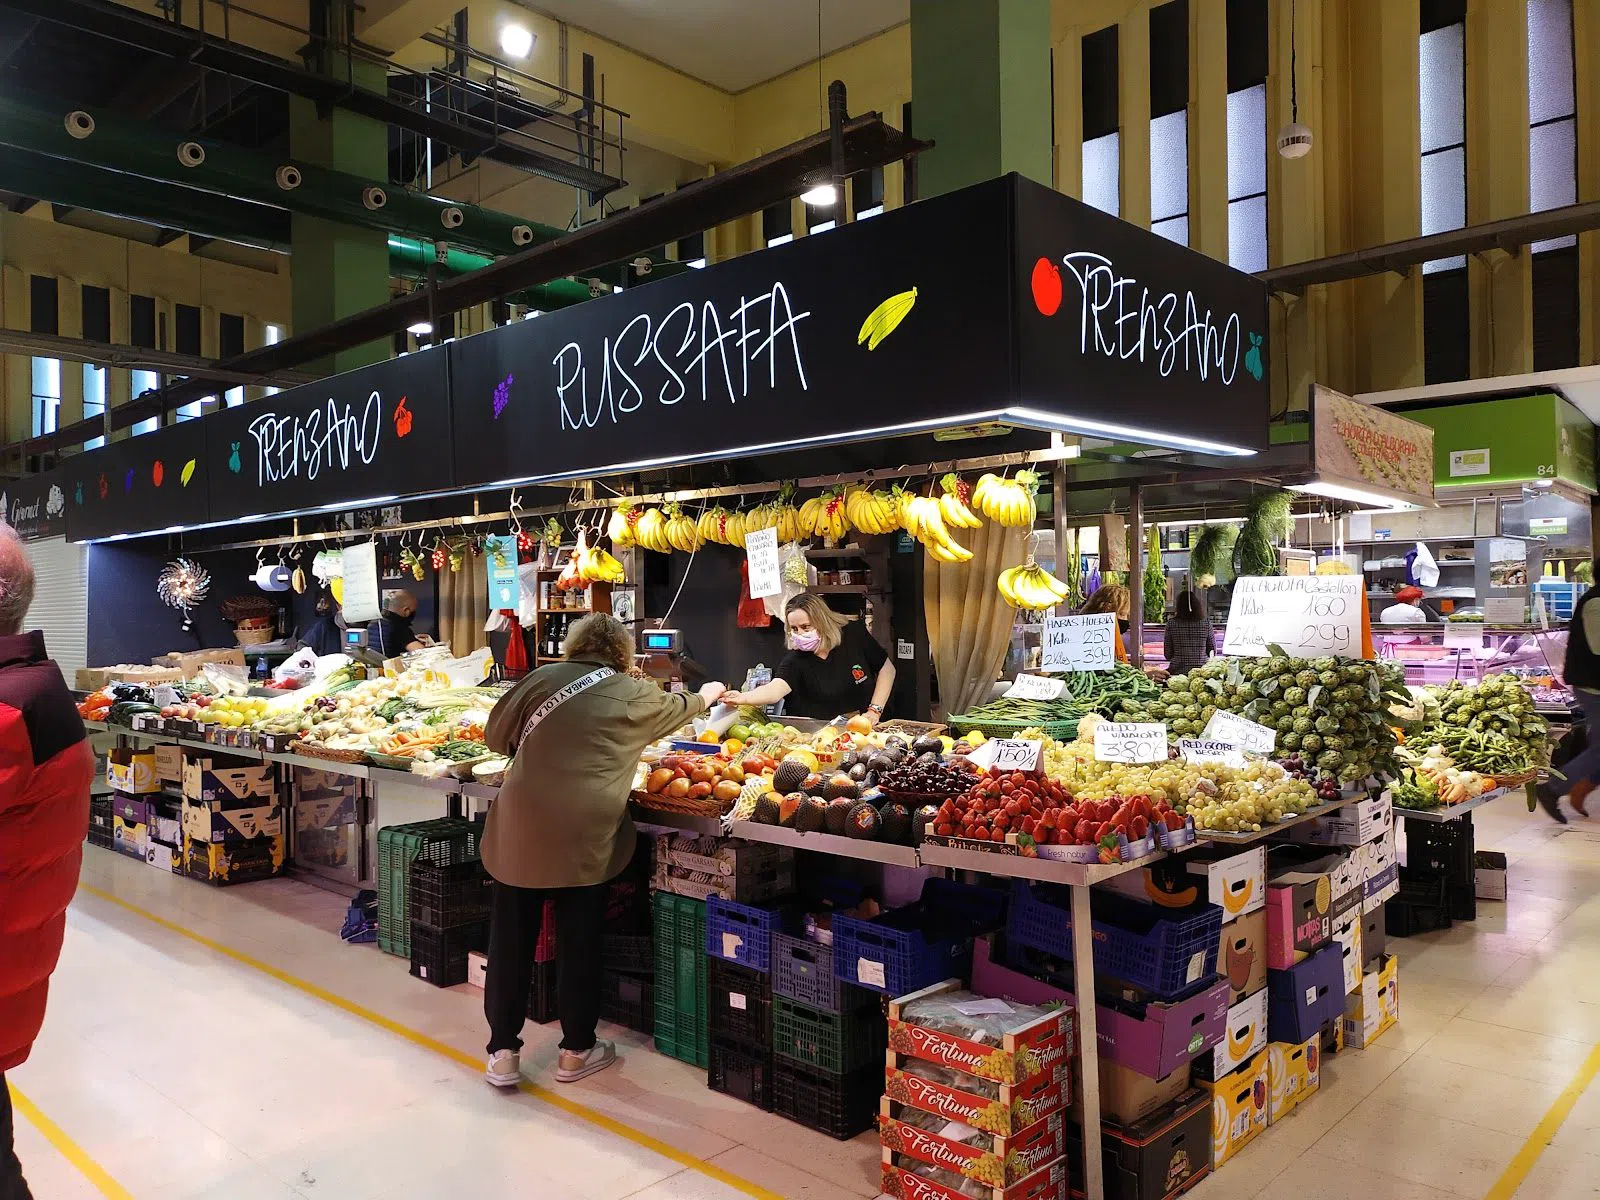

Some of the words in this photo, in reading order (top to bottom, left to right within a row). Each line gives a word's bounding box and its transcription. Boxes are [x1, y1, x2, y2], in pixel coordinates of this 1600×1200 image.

[552, 281, 811, 430] RUSSAFA
[1537, 464, 1554, 475] 84
[1082, 615, 1114, 626] HUERTA
[564, 676, 594, 696] BIMBA
[535, 696, 560, 718] LOLA
[1182, 740, 1202, 749] RED
[1047, 850, 1066, 858] Fresh
[911, 1027, 985, 1068] Fortuna
[1025, 1043, 1064, 1070] Fortuna
[908, 1077, 982, 1120] Fortuna
[1020, 1092, 1058, 1119] Fortuna
[901, 1126, 976, 1170] Fortuna
[1014, 1143, 1053, 1170] Fortuna
